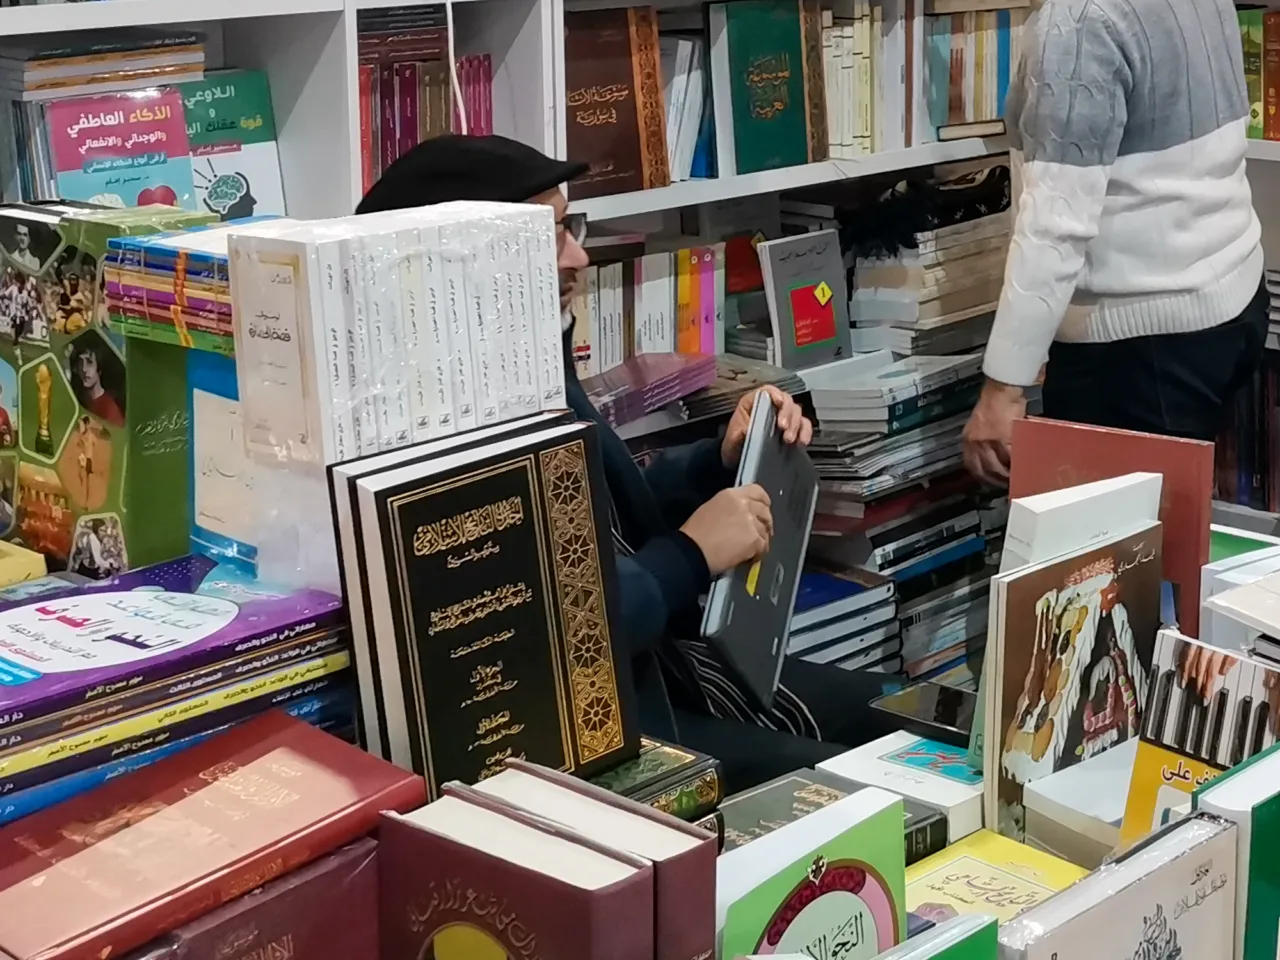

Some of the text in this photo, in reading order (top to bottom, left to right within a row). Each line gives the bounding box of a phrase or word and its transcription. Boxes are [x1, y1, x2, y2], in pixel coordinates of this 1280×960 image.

[183, 84, 236, 108] اللاوعي
[66, 105, 171, 138] الذكاء العاطفي
[203, 114, 263, 133] قوة عقلك
[207, 108, 217, 119] و
[290, 621, 317, 636] مهاراتي
[1161, 761, 1191, 782] على
